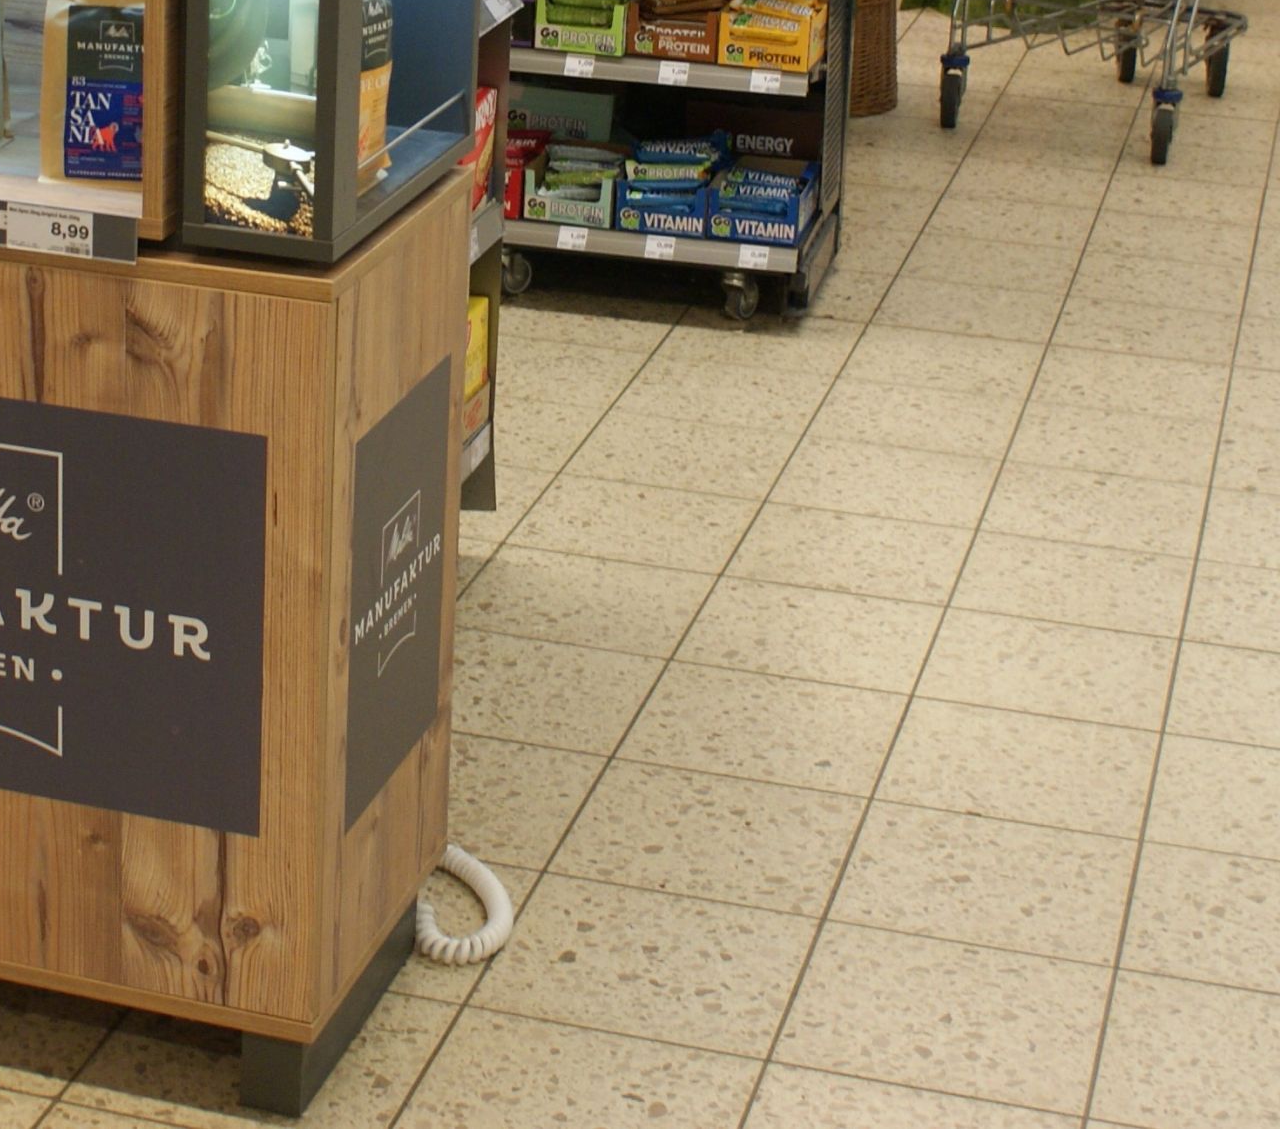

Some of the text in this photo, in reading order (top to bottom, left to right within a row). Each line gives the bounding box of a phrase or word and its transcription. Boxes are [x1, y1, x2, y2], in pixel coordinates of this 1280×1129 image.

[658, 39, 709, 54] PROTEIN
[749, 51, 800, 65] PROTEIN
[72, 76, 85, 86] 83
[70, 91, 111, 110] TAN
[70, 110, 94, 124] SA
[68, 123, 103, 145] NIA
[737, 134, 794, 152] ENERGY
[50, 223, 89, 239] 8,99
[644, 212, 703, 232] VITAMIN
[735, 219, 794, 239] VITAMIN
[354, 533, 440, 645] MANUFAKTUR
